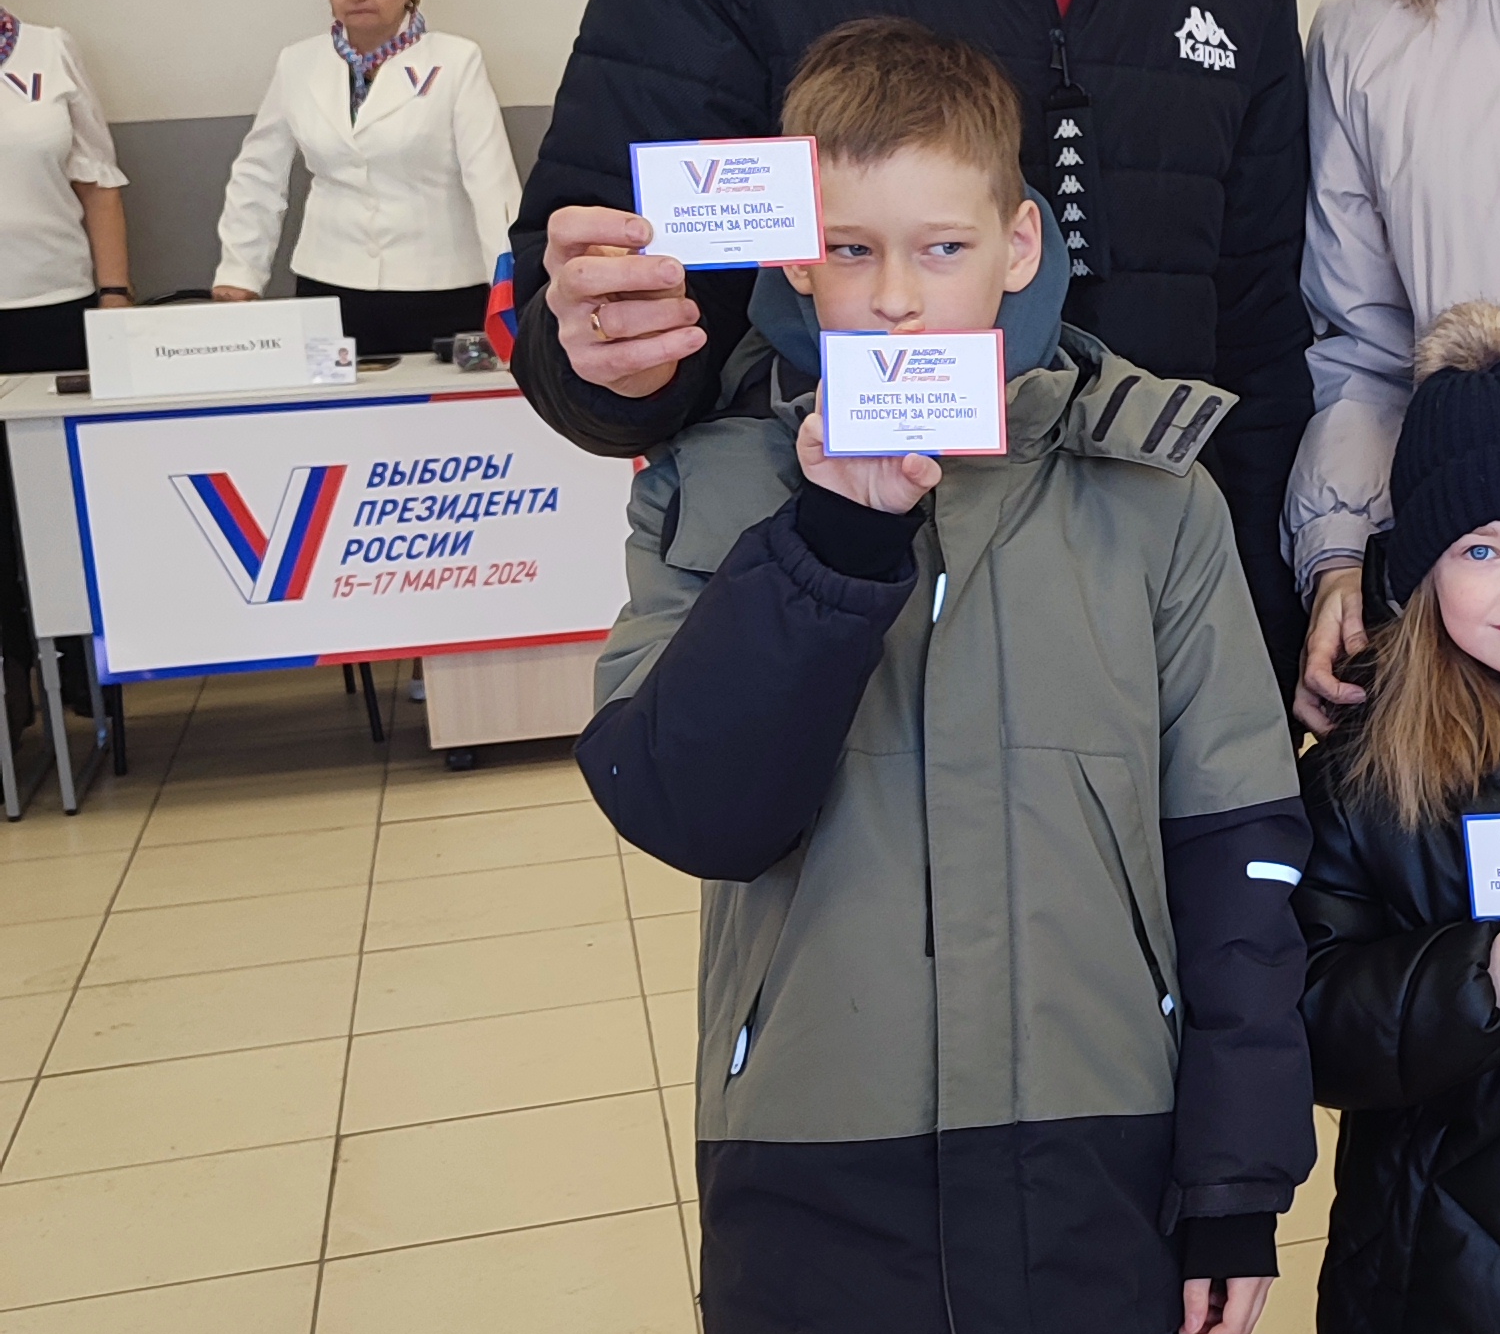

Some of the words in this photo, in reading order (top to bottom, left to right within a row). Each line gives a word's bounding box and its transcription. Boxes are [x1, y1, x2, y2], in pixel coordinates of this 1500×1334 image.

[1179, 37, 1236, 71] Kappa
[673, 204, 717, 218] ВМЕСТЕ
[720, 204, 740, 216] МЫ
[743, 203, 774, 214] СИЛА
[665, 220, 724, 234] ГОЛОСУЕМ
[726, 220, 741, 231] ЗА
[744, 217, 795, 230] РОССИЮ!
[250, 338, 282, 351] УИК
[859, 393, 902, 405] ВМЕСТЕ
[905, 393, 925, 404] МЫ
[927, 392, 957, 404] СИЛА
[850, 408, 908, 421] ГОЛОСУЕМ
[910, 408, 925, 419] ЗА
[927, 408, 978, 419] РОССИЮ!
[366, 453, 513, 489] ВЫБОРЫ
[353, 487, 559, 527] ПРЕЗИДЕНТА
[340, 530, 475, 566] РОССИИ
[399, 565, 478, 593] МАРТА
[483, 560, 539, 587] 2024
